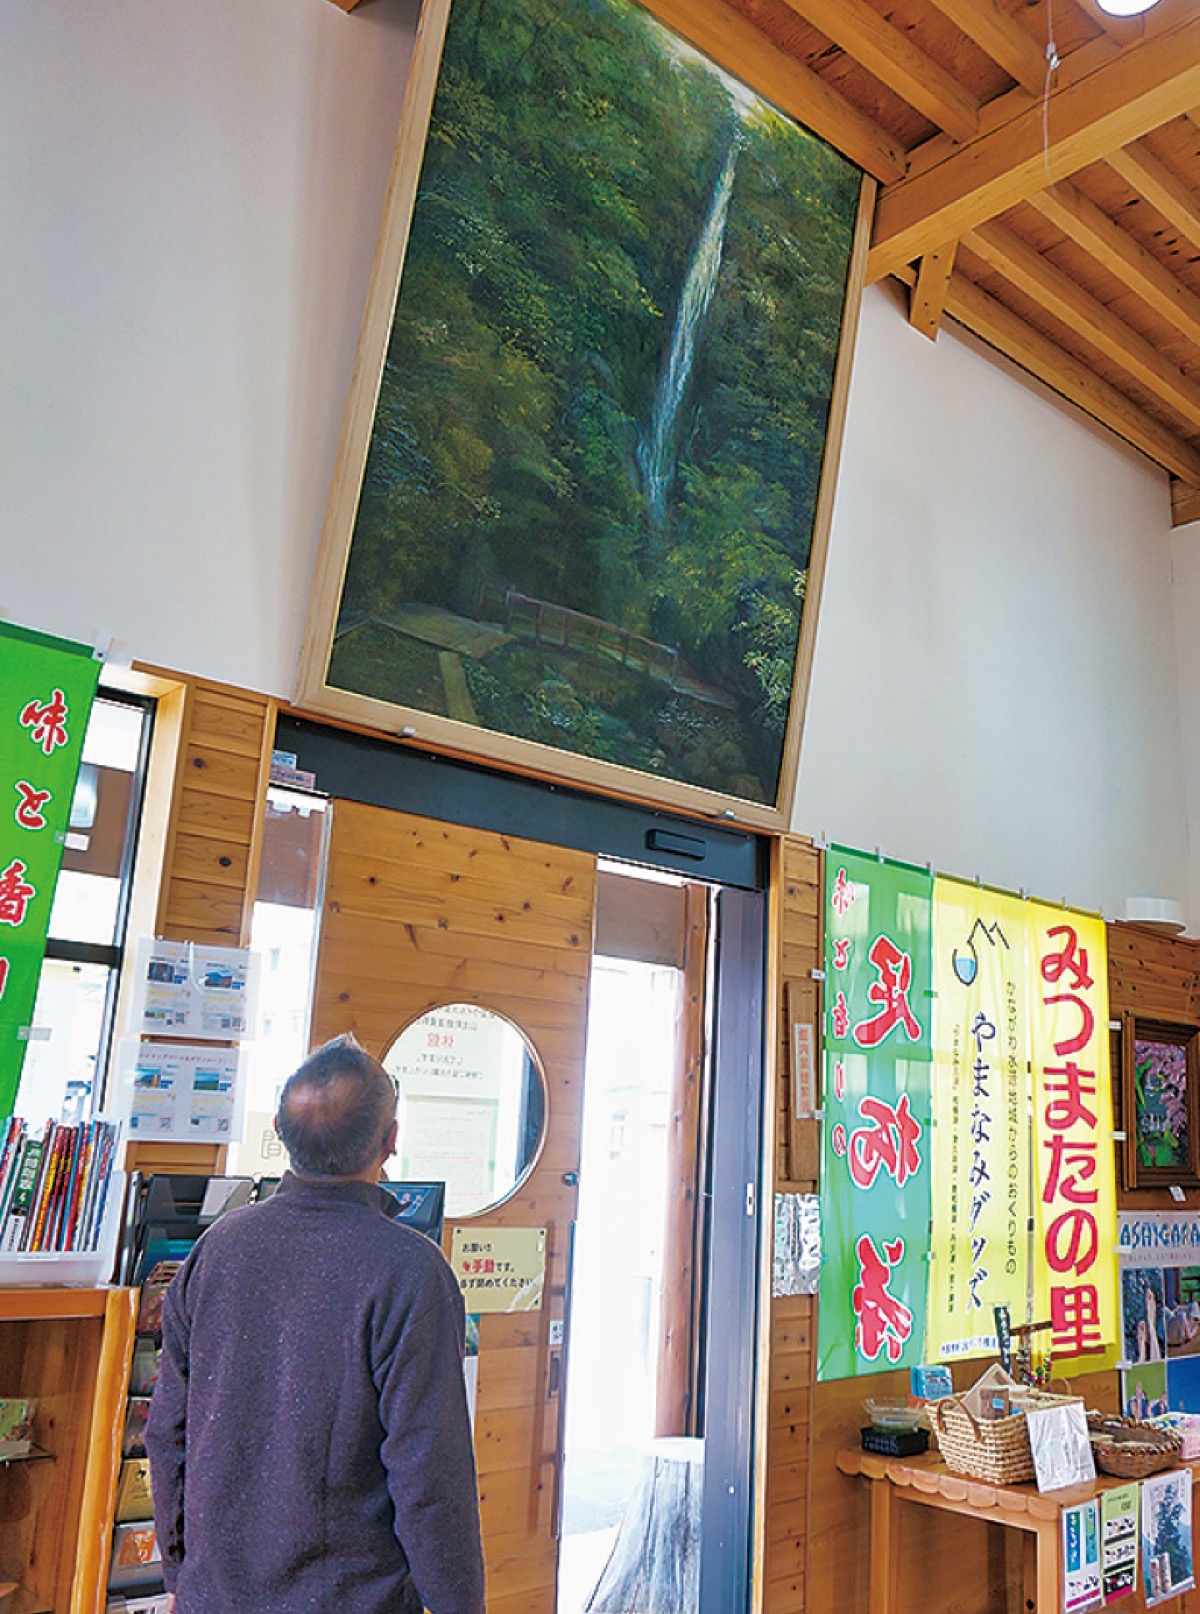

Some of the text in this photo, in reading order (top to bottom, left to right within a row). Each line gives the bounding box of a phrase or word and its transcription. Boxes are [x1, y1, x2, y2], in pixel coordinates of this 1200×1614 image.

[966, 1010, 997, 1312] やまなみグッズ
[1040, 925, 1107, 1359] みつまたの里
